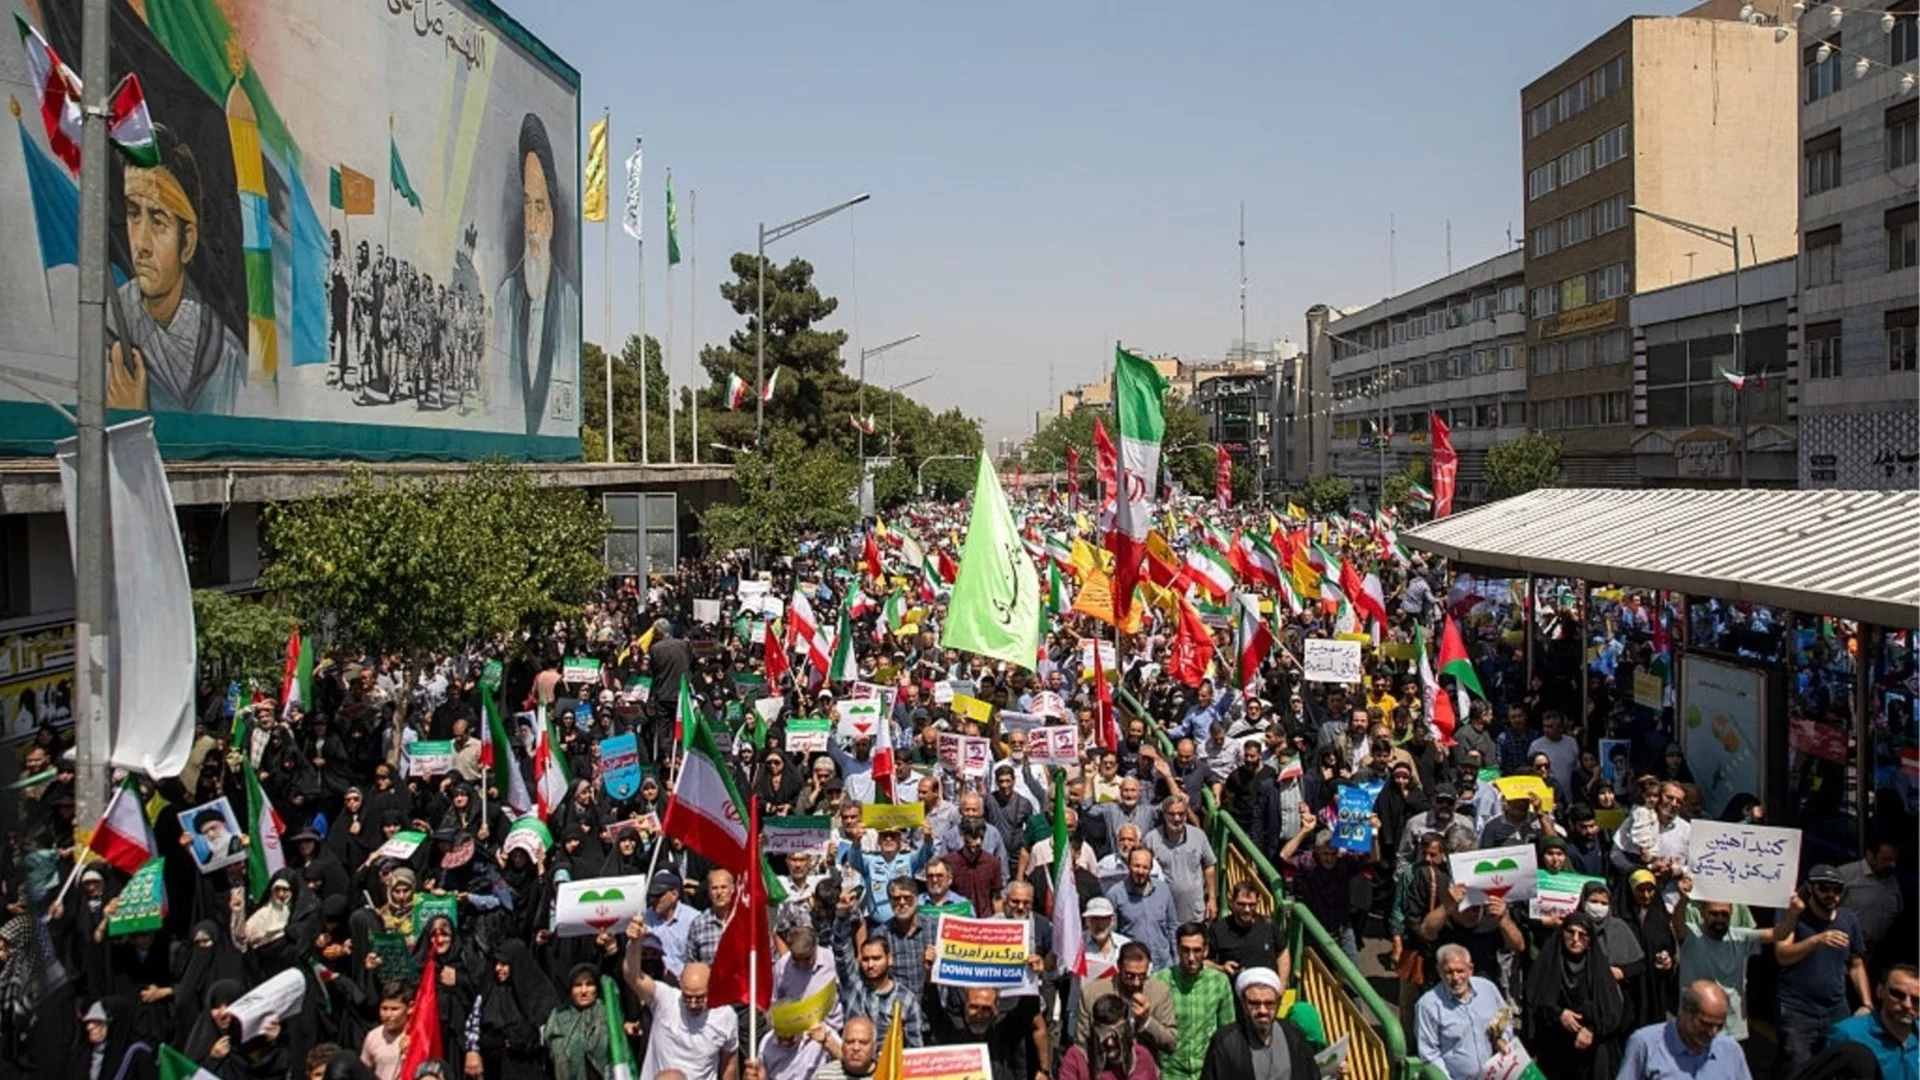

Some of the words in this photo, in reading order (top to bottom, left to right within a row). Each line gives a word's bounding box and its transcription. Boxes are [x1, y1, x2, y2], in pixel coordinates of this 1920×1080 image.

[941, 962, 974, 977] DOWN
[974, 966, 1002, 977] WITH
[1002, 967, 1023, 978] USA
